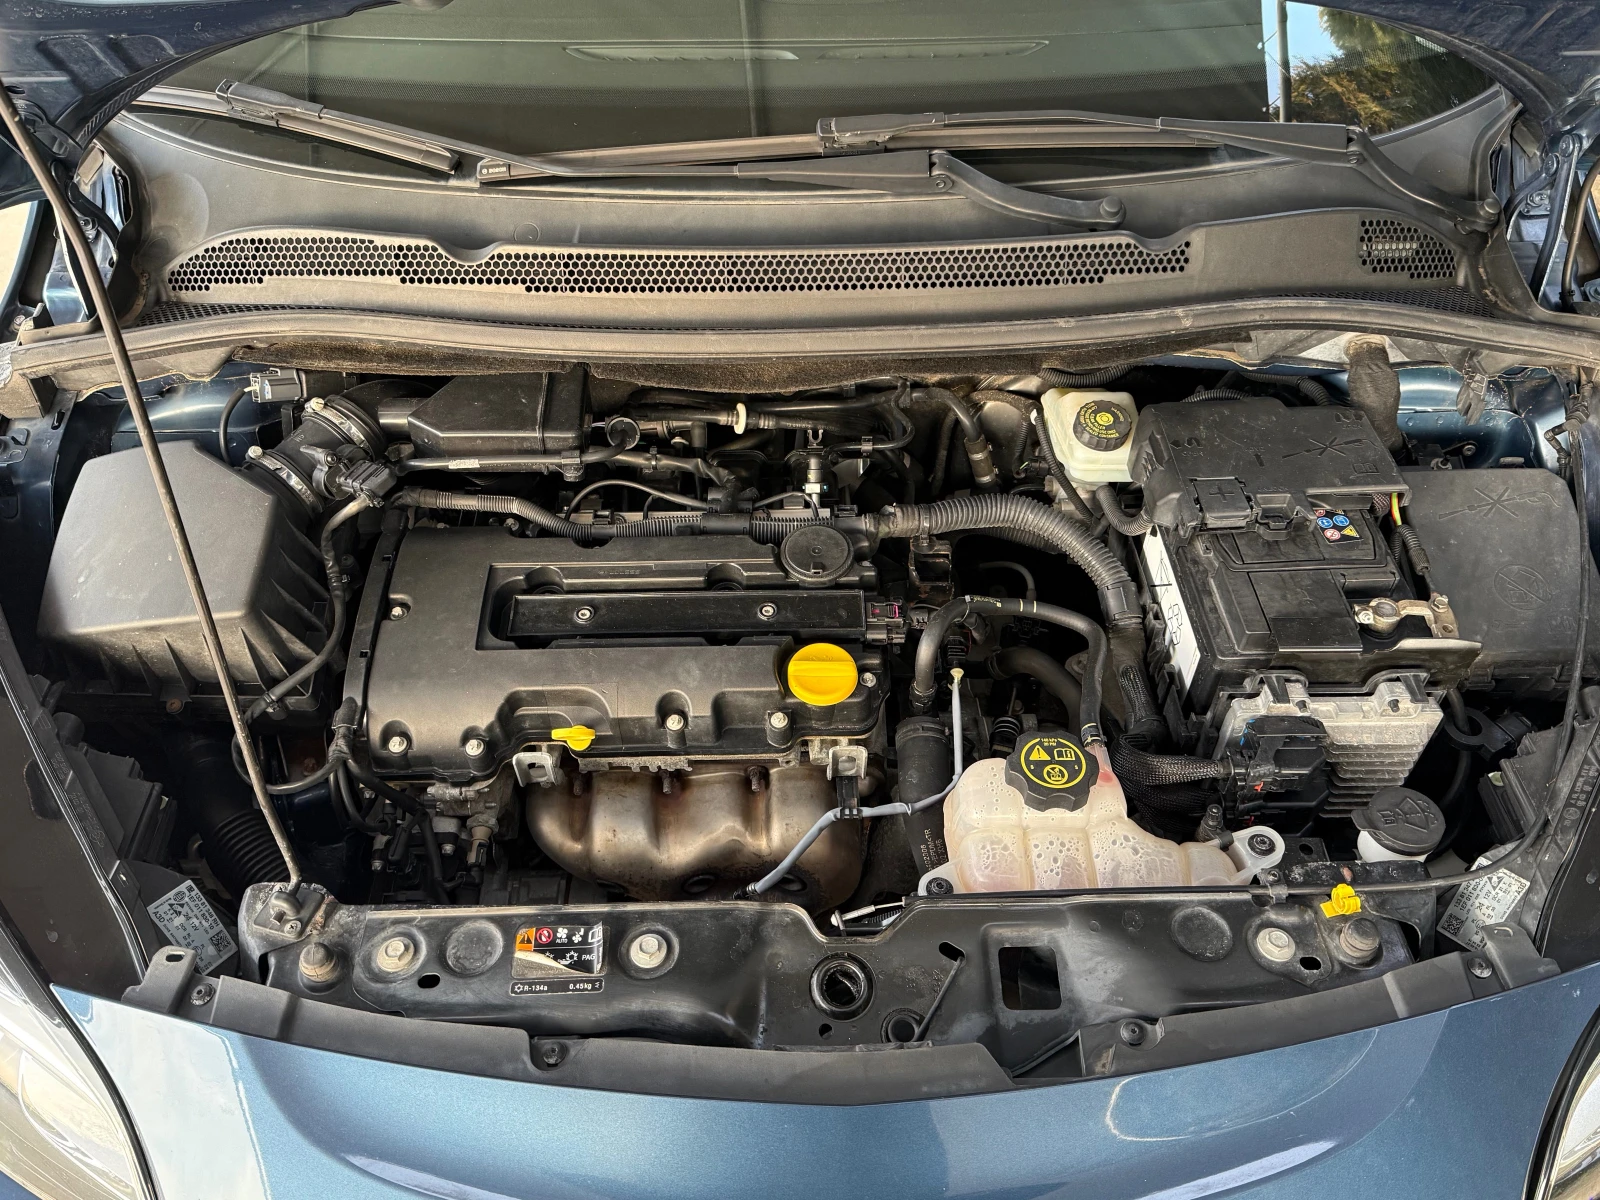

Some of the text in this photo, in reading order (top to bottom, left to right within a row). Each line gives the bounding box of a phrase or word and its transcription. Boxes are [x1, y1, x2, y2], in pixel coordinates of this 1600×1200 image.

[1515, 881, 1527, 896] A3D
[1483, 889, 1492, 900] 12V
[194, 903, 203, 913] 011
[153, 909, 166, 924] A3D
[190, 921, 199, 932] 12V
[212, 918, 220, 927] RH
